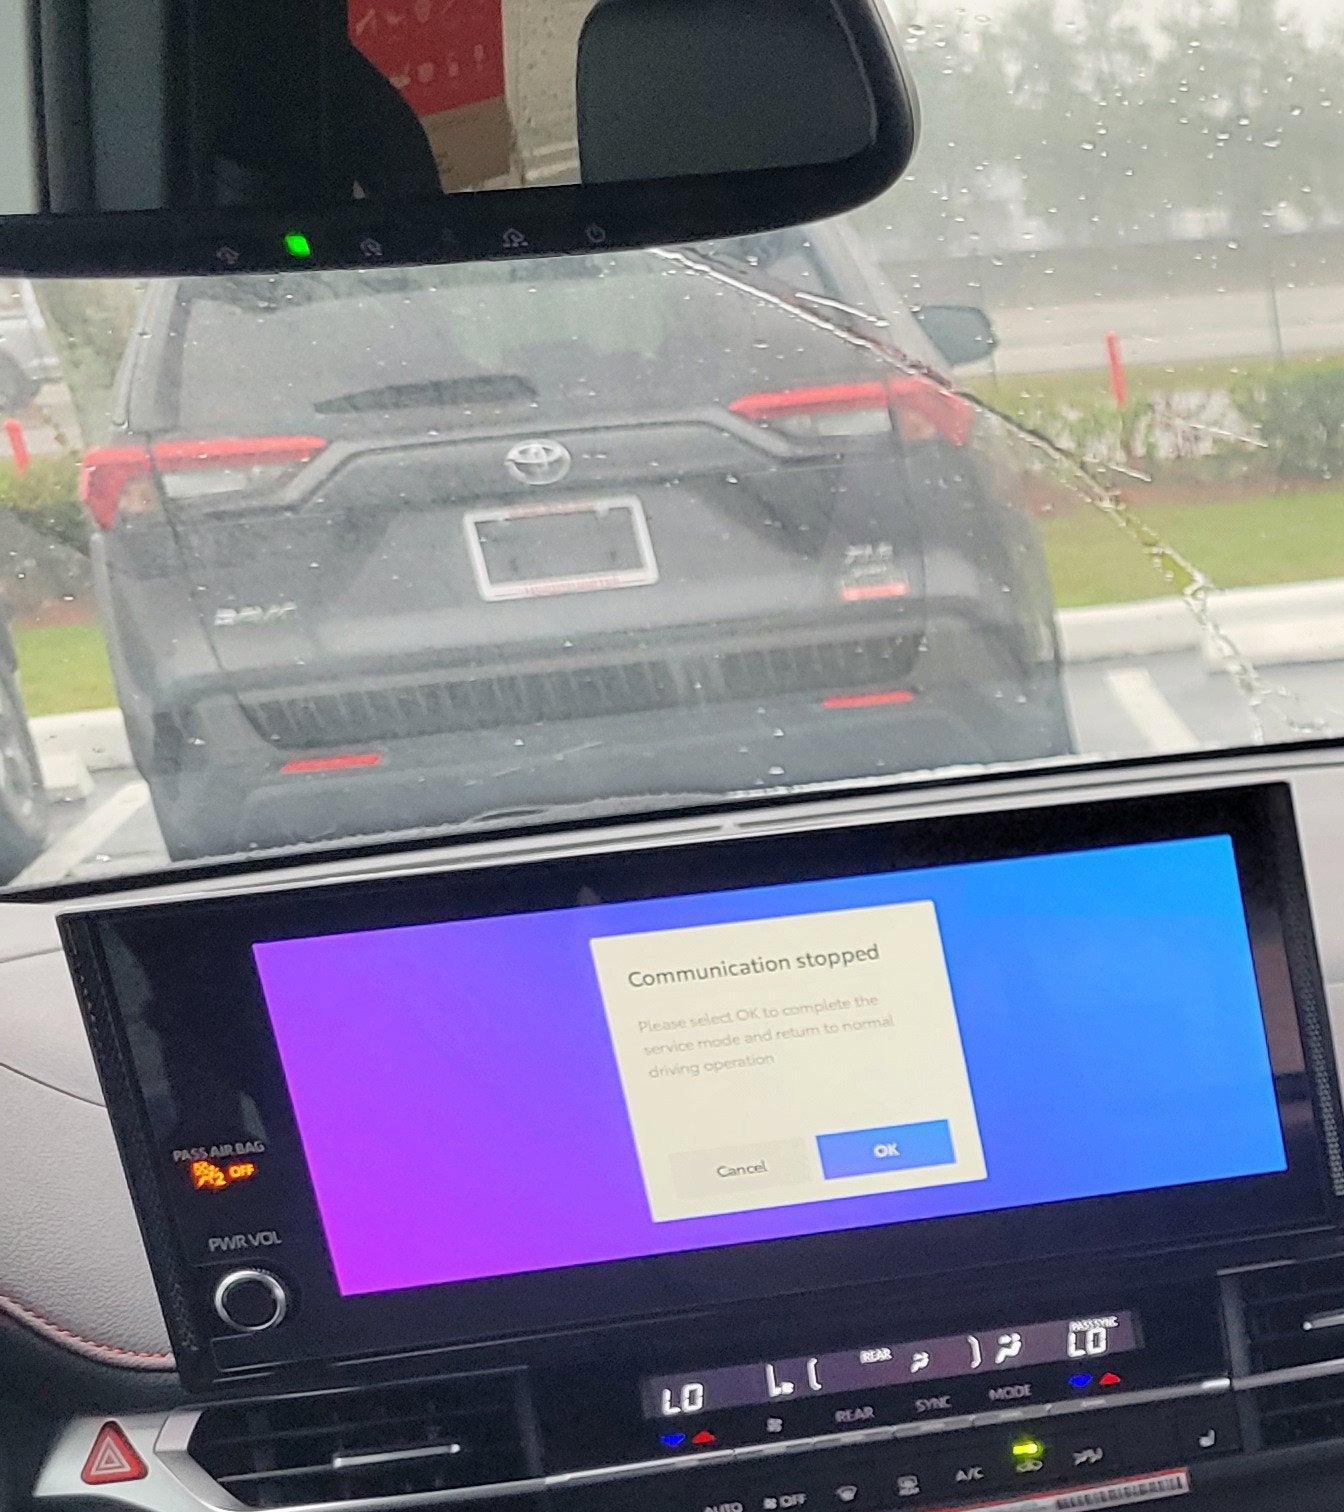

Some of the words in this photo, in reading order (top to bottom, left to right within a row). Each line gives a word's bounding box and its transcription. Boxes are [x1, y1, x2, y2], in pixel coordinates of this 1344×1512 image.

[627, 955, 791, 988] Communication
[796, 944, 880, 971] stopped
[638, 1018, 686, 1034] Please
[690, 1012, 733, 1029] select
[736, 1006, 761, 1021] OK
[764, 1005, 779, 1018] to
[782, 998, 850, 1019] complete
[854, 993, 879, 1008] the
[644, 1039, 695, 1056] service
[698, 1033, 741, 1050] mode
[745, 1028, 773, 1044] and
[776, 1022, 820, 1040] return
[824, 1021, 840, 1034] to
[843, 1015, 894, 1032] normal
[648, 1060, 700, 1079] driving
[704, 1053, 775, 1073] operation
[172, 1147, 208, 1161] PASS
[210, 1144, 234, 1158] AIR
[235, 1140, 265, 1155] BAG
[873, 1142, 900, 1158] OK
[228, 1163, 255, 1178] OFF
[717, 1160, 769, 1177] Cancel
[208, 1234, 248, 1252] PWR
[247, 1231, 282, 1246] VOL
[859, 1347, 893, 1364] REAR
[988, 1384, 1032, 1401] MODE
[915, 1395, 952, 1413] SYNC
[835, 1406, 875, 1423] REAR
[956, 1466, 984, 1482] A/C
[779, 1493, 807, 1508] OFF
